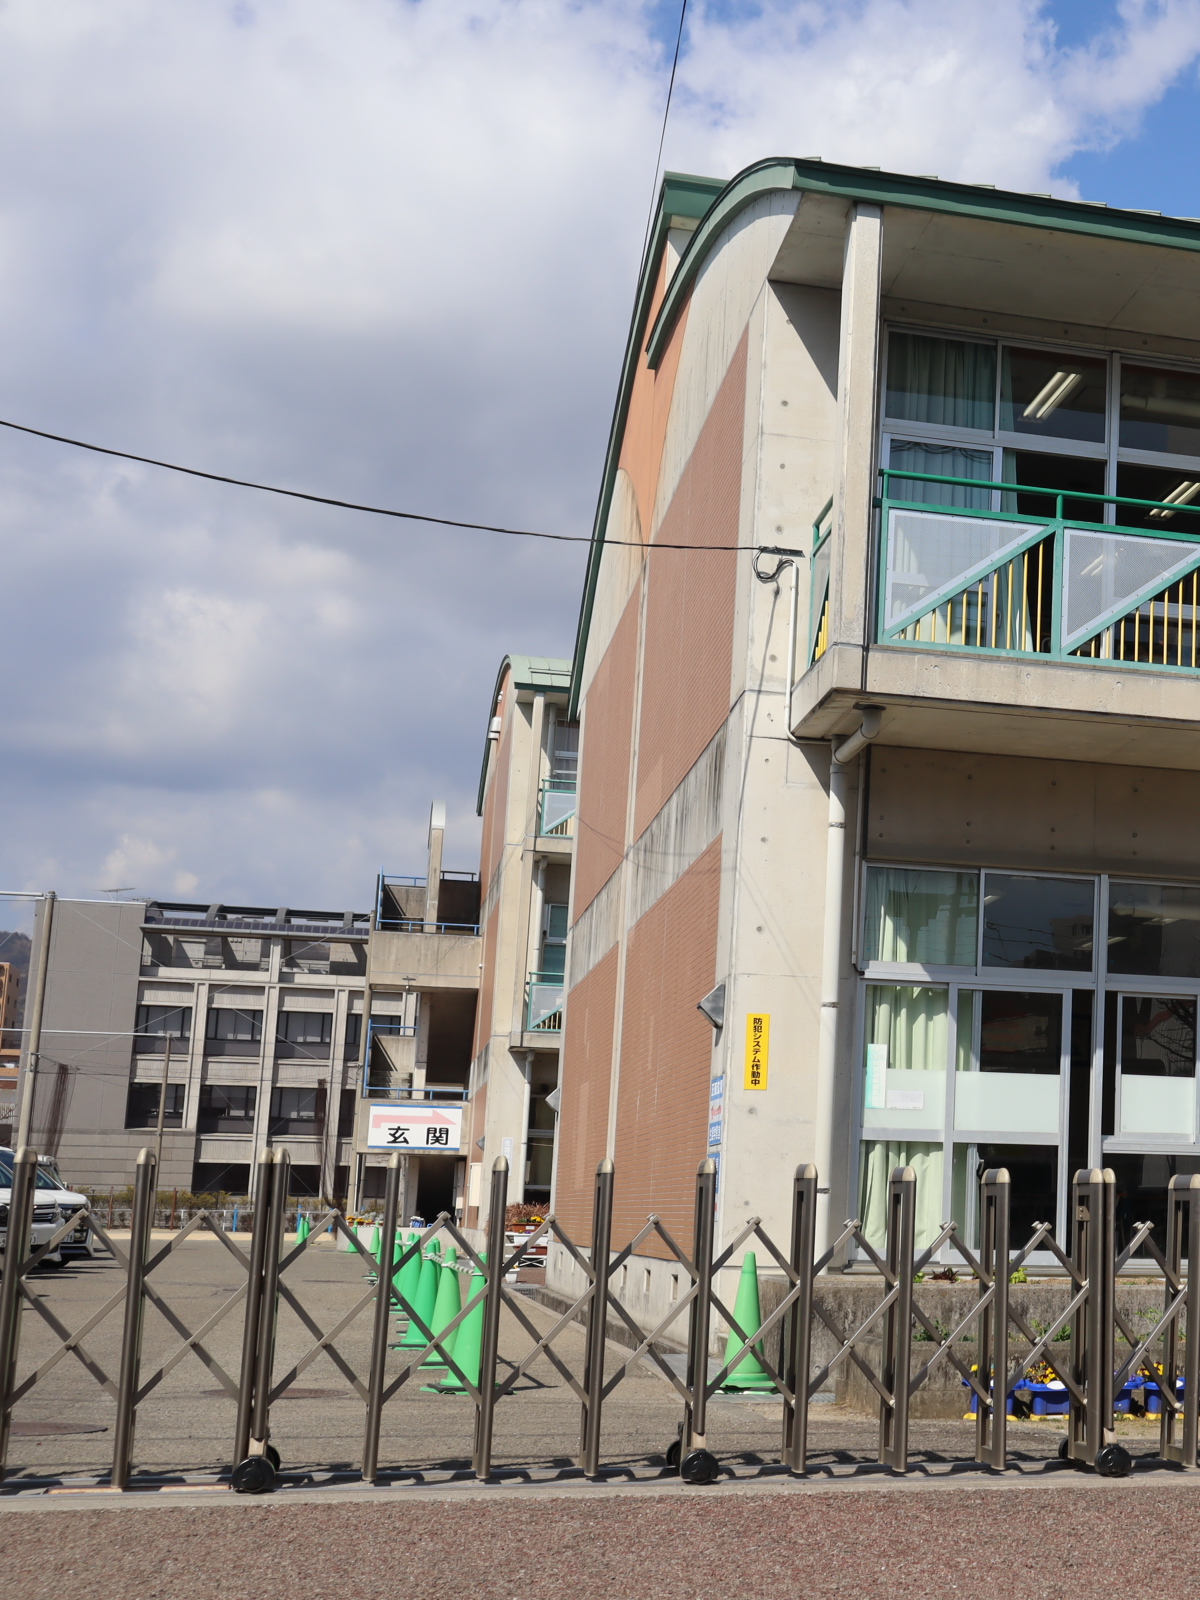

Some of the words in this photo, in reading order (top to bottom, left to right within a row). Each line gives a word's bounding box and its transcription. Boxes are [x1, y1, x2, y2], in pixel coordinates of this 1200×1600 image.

[751, 1017, 763, 1086] 防犯システム作動中
[386, 1126, 449, 1146] 玄関
